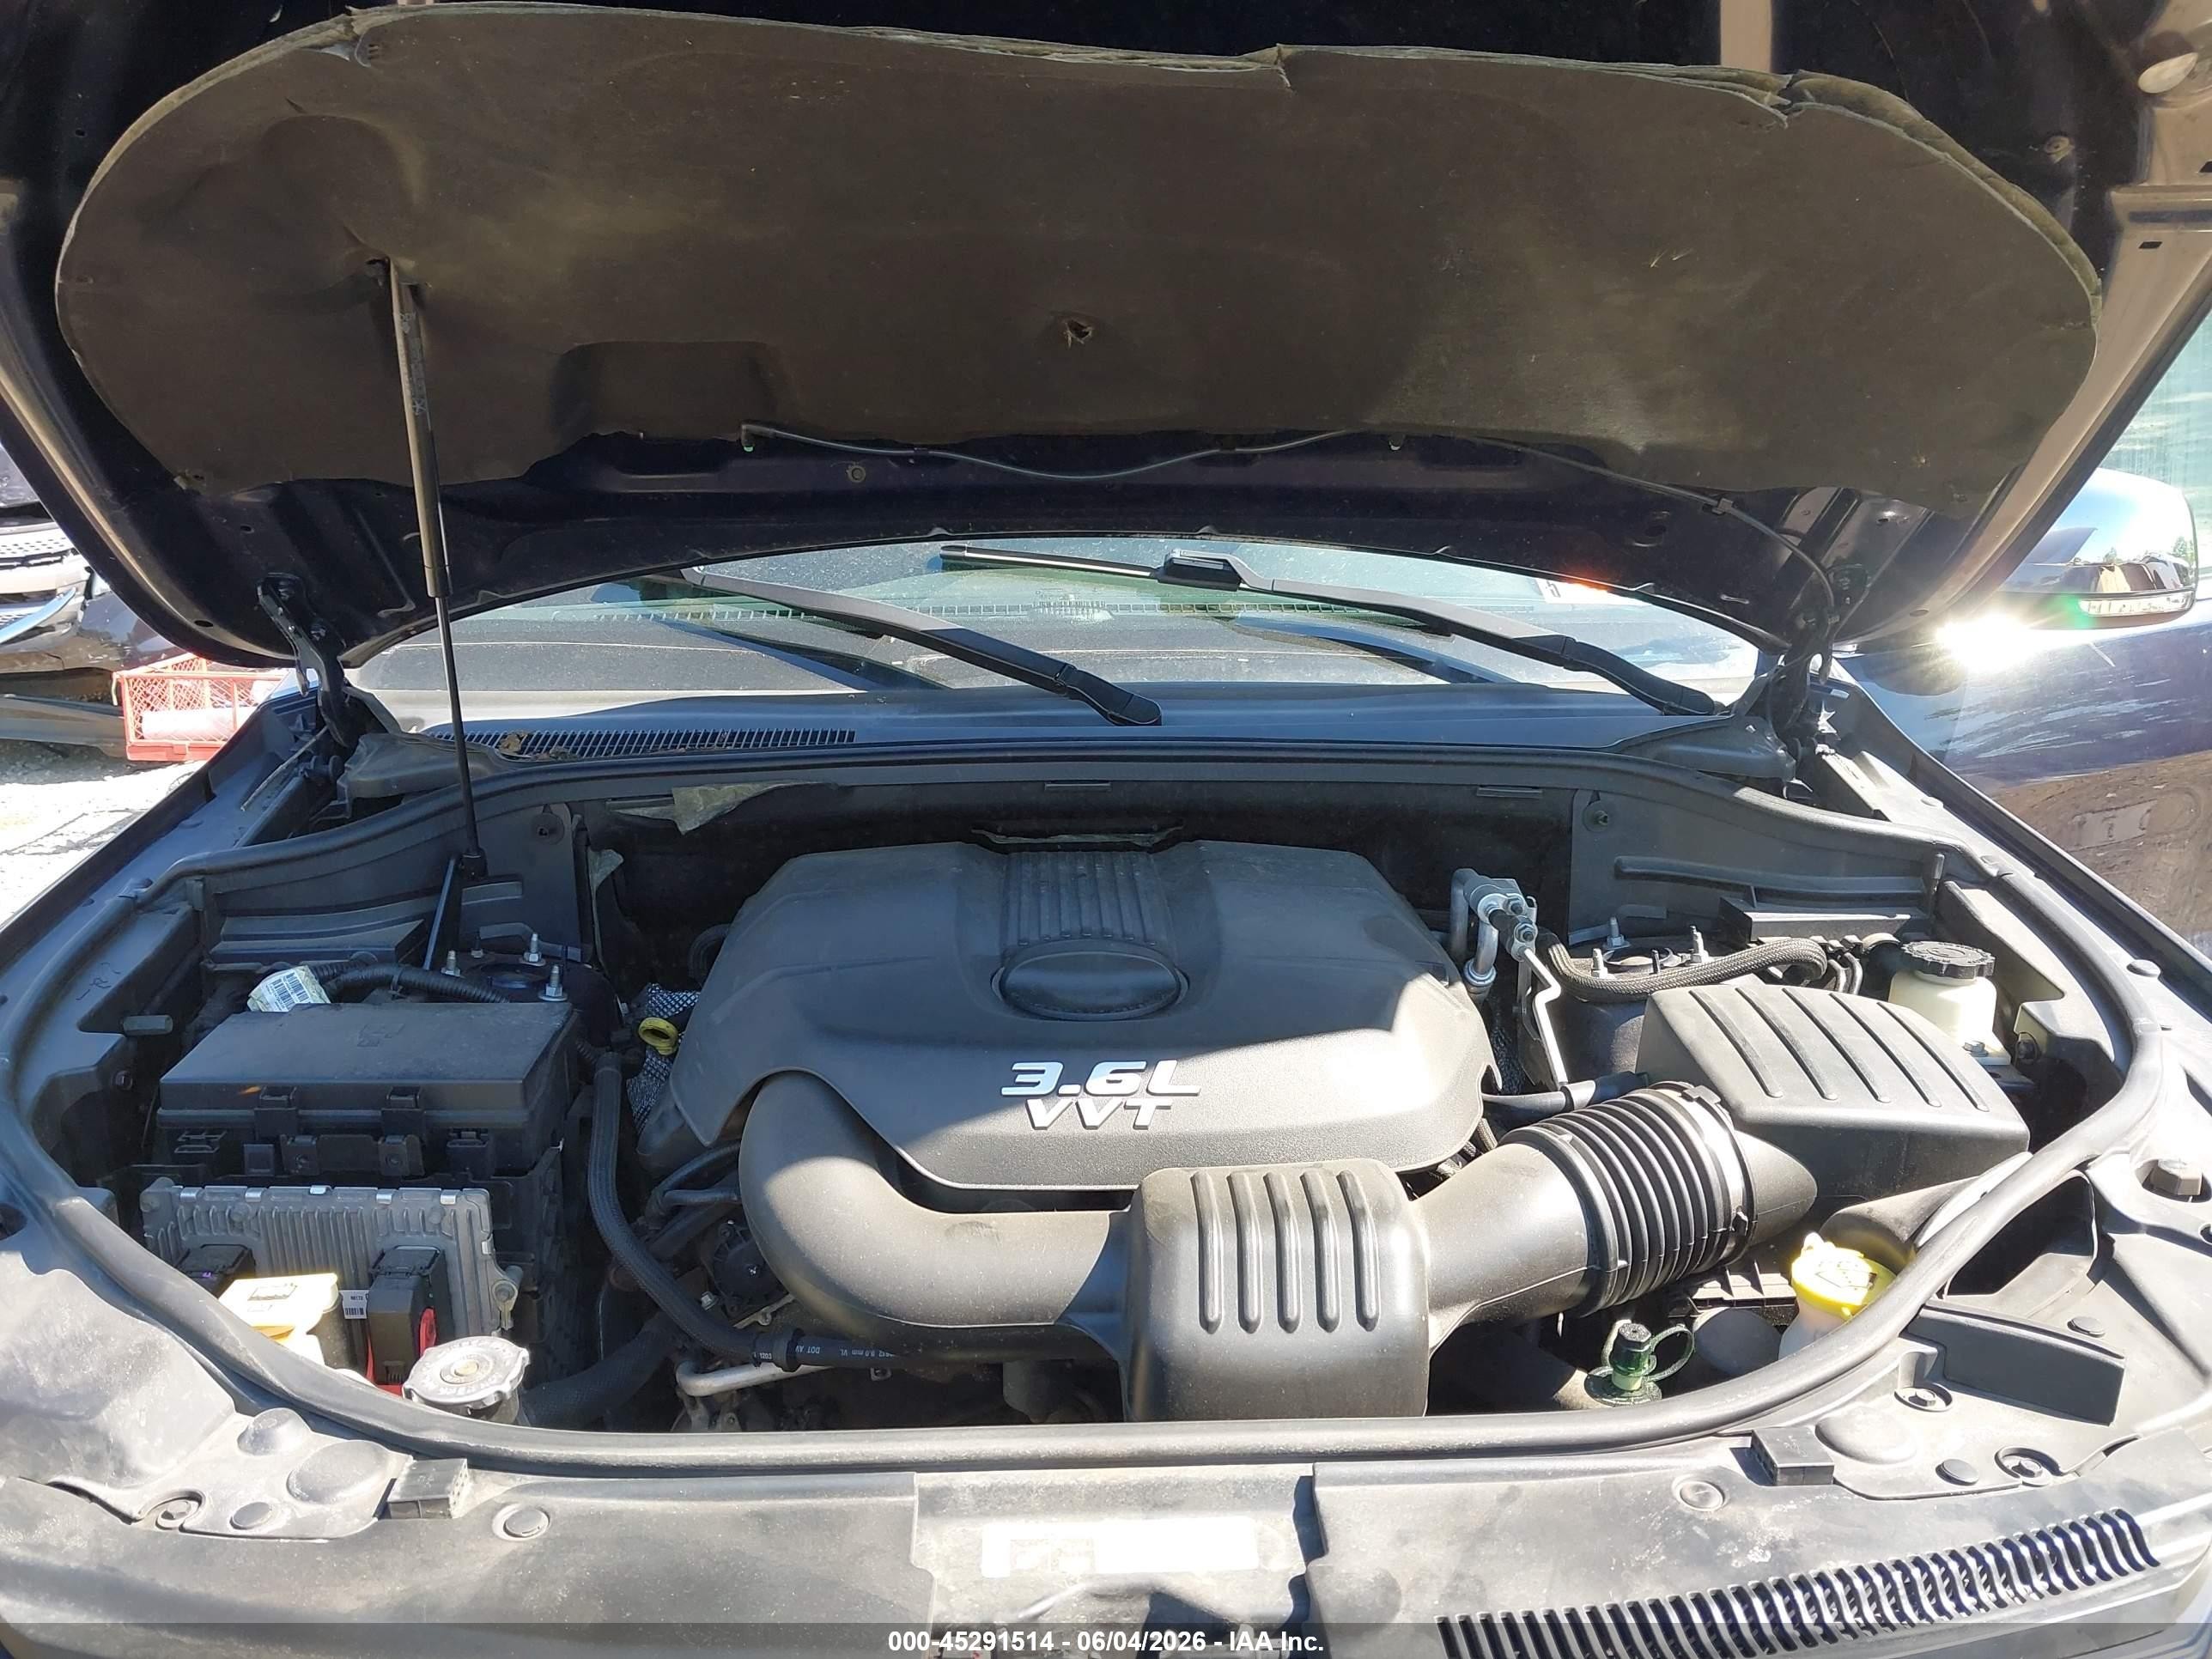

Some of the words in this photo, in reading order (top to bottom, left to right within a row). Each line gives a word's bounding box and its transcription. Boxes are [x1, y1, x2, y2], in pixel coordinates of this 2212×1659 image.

[1001, 1060, 1201, 1097] 3.6L
[1025, 1097, 1172, 1131] VVT
[807, 1346, 821, 1354] DOT
